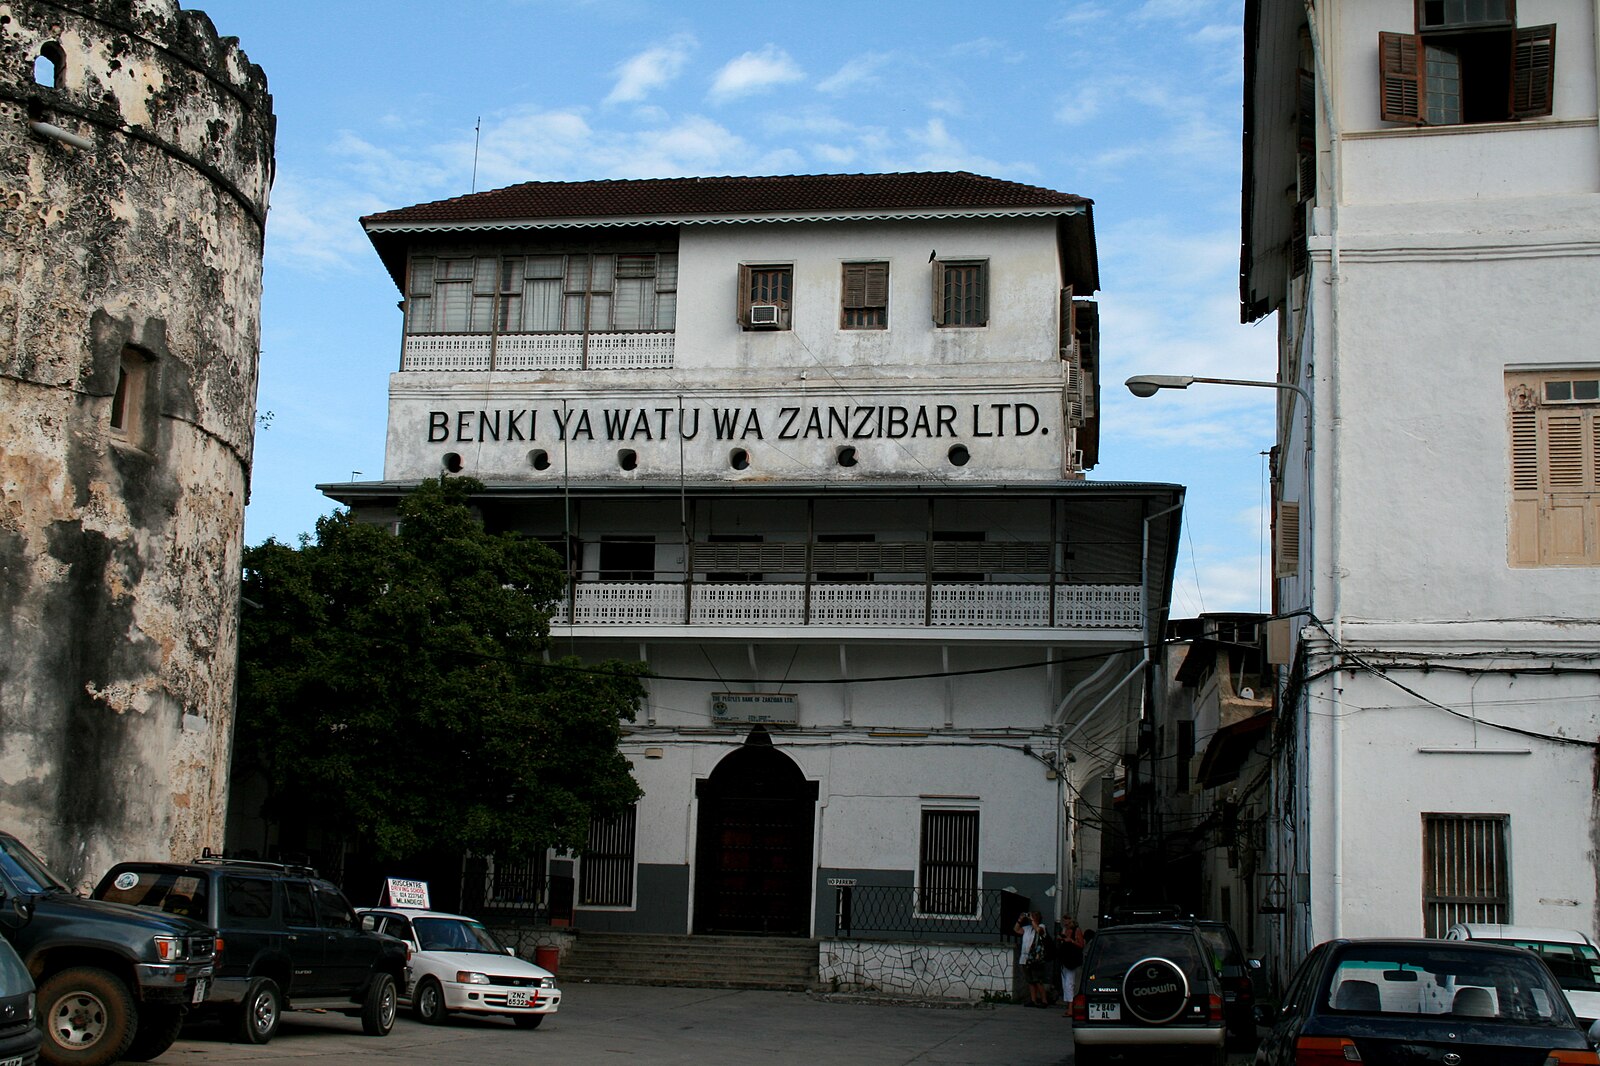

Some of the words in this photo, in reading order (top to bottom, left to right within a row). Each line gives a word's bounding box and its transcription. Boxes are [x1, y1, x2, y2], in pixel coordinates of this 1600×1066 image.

[427, 409, 538, 443] BENKI
[552, 408, 595, 441] YA
[603, 407, 700, 441] WATU
[712, 407, 764, 440] WA
[777, 404, 958, 440] ZANZIBAR
[972, 403, 1050, 438] LTD.
